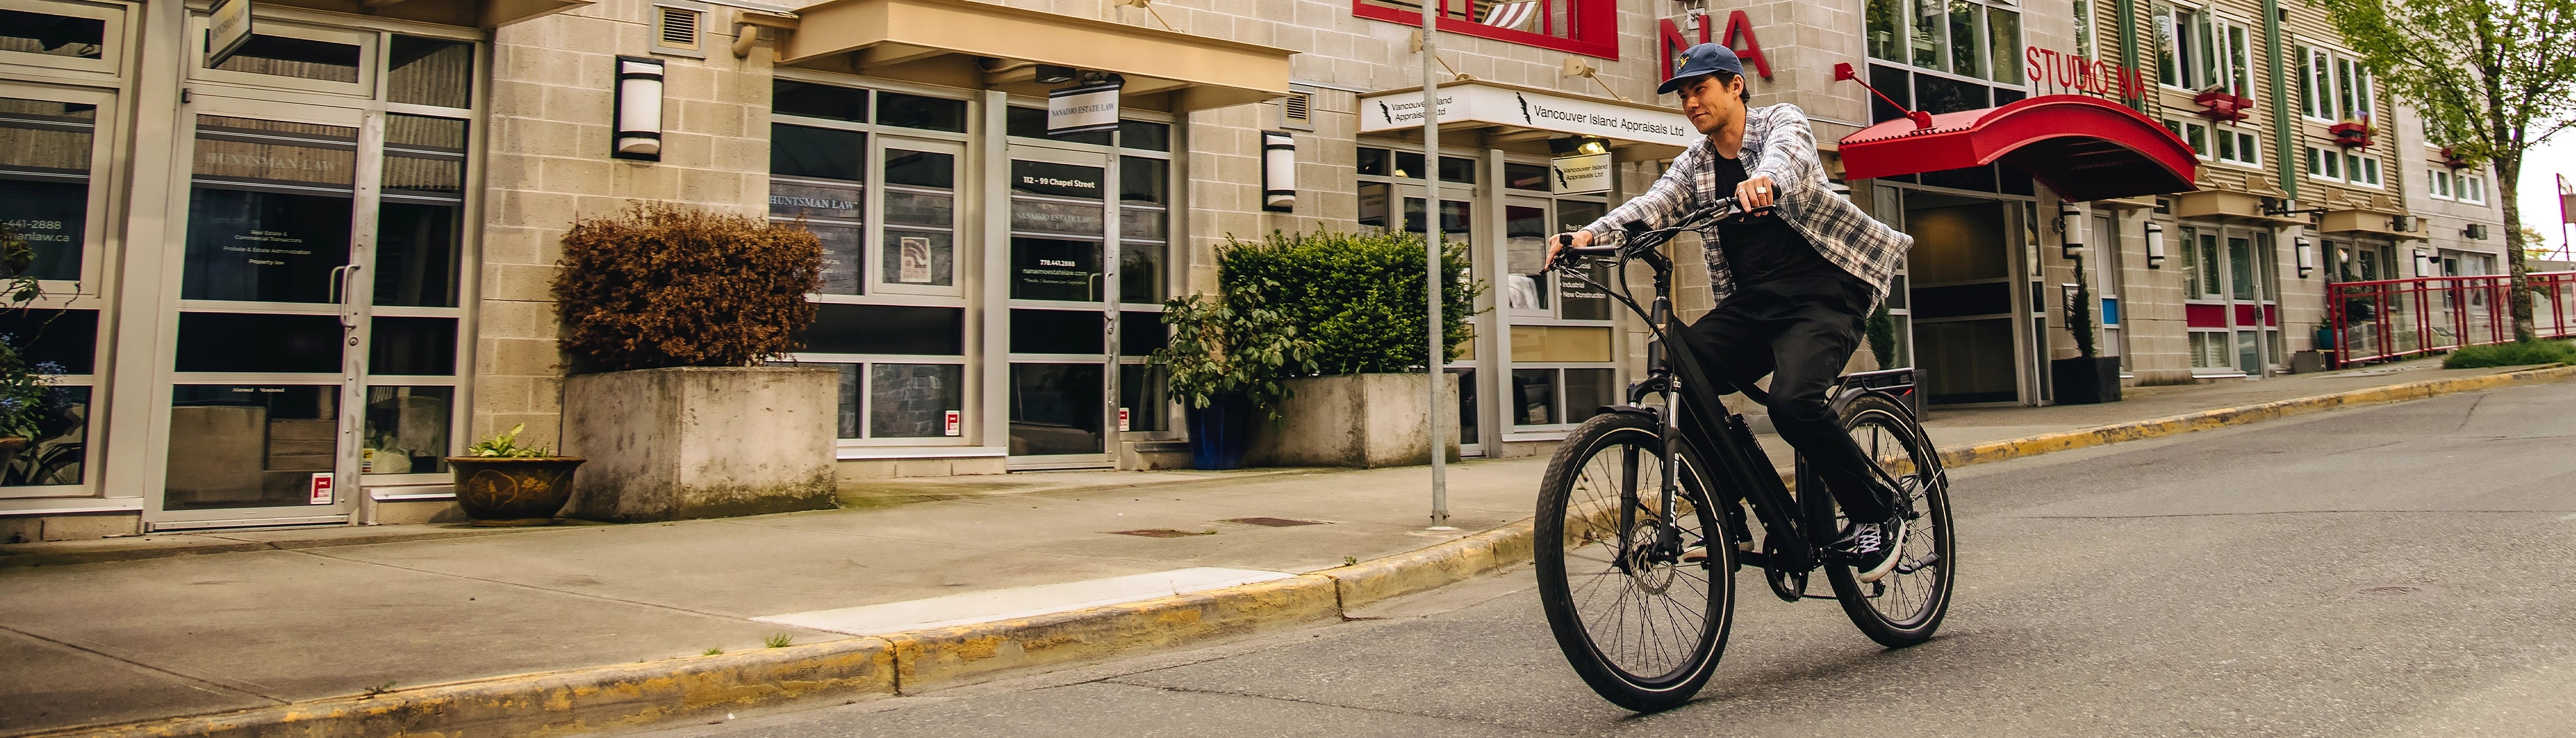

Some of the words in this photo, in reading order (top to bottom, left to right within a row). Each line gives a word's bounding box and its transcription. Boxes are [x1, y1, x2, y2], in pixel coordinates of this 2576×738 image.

[1660, 10, 1772, 83] NA
[2027, 45, 2109, 94] STUDIO
[2117, 64, 2148, 103] NA
[1078, 104, 1099, 114] ESTATE
[1101, 103, 1115, 111] LAW
[1391, 101, 1425, 111] Vancouve
[1395, 111, 1425, 122] Appraisa
[1534, 104, 1587, 123] Vancouver
[1590, 113, 1617, 127] Island
[1621, 118, 1668, 135] Appraisals
[1670, 125, 1684, 137] Ltd
[206, 152, 298, 168] HUNTSMAN
[1566, 172, 1594, 181] Appraisals
[1049, 178, 1073, 187] Chapel
[1074, 179, 1095, 189] Street
[770, 195, 830, 208] HUNTSMAN
[0, 219, 62, 229] -441-2888
